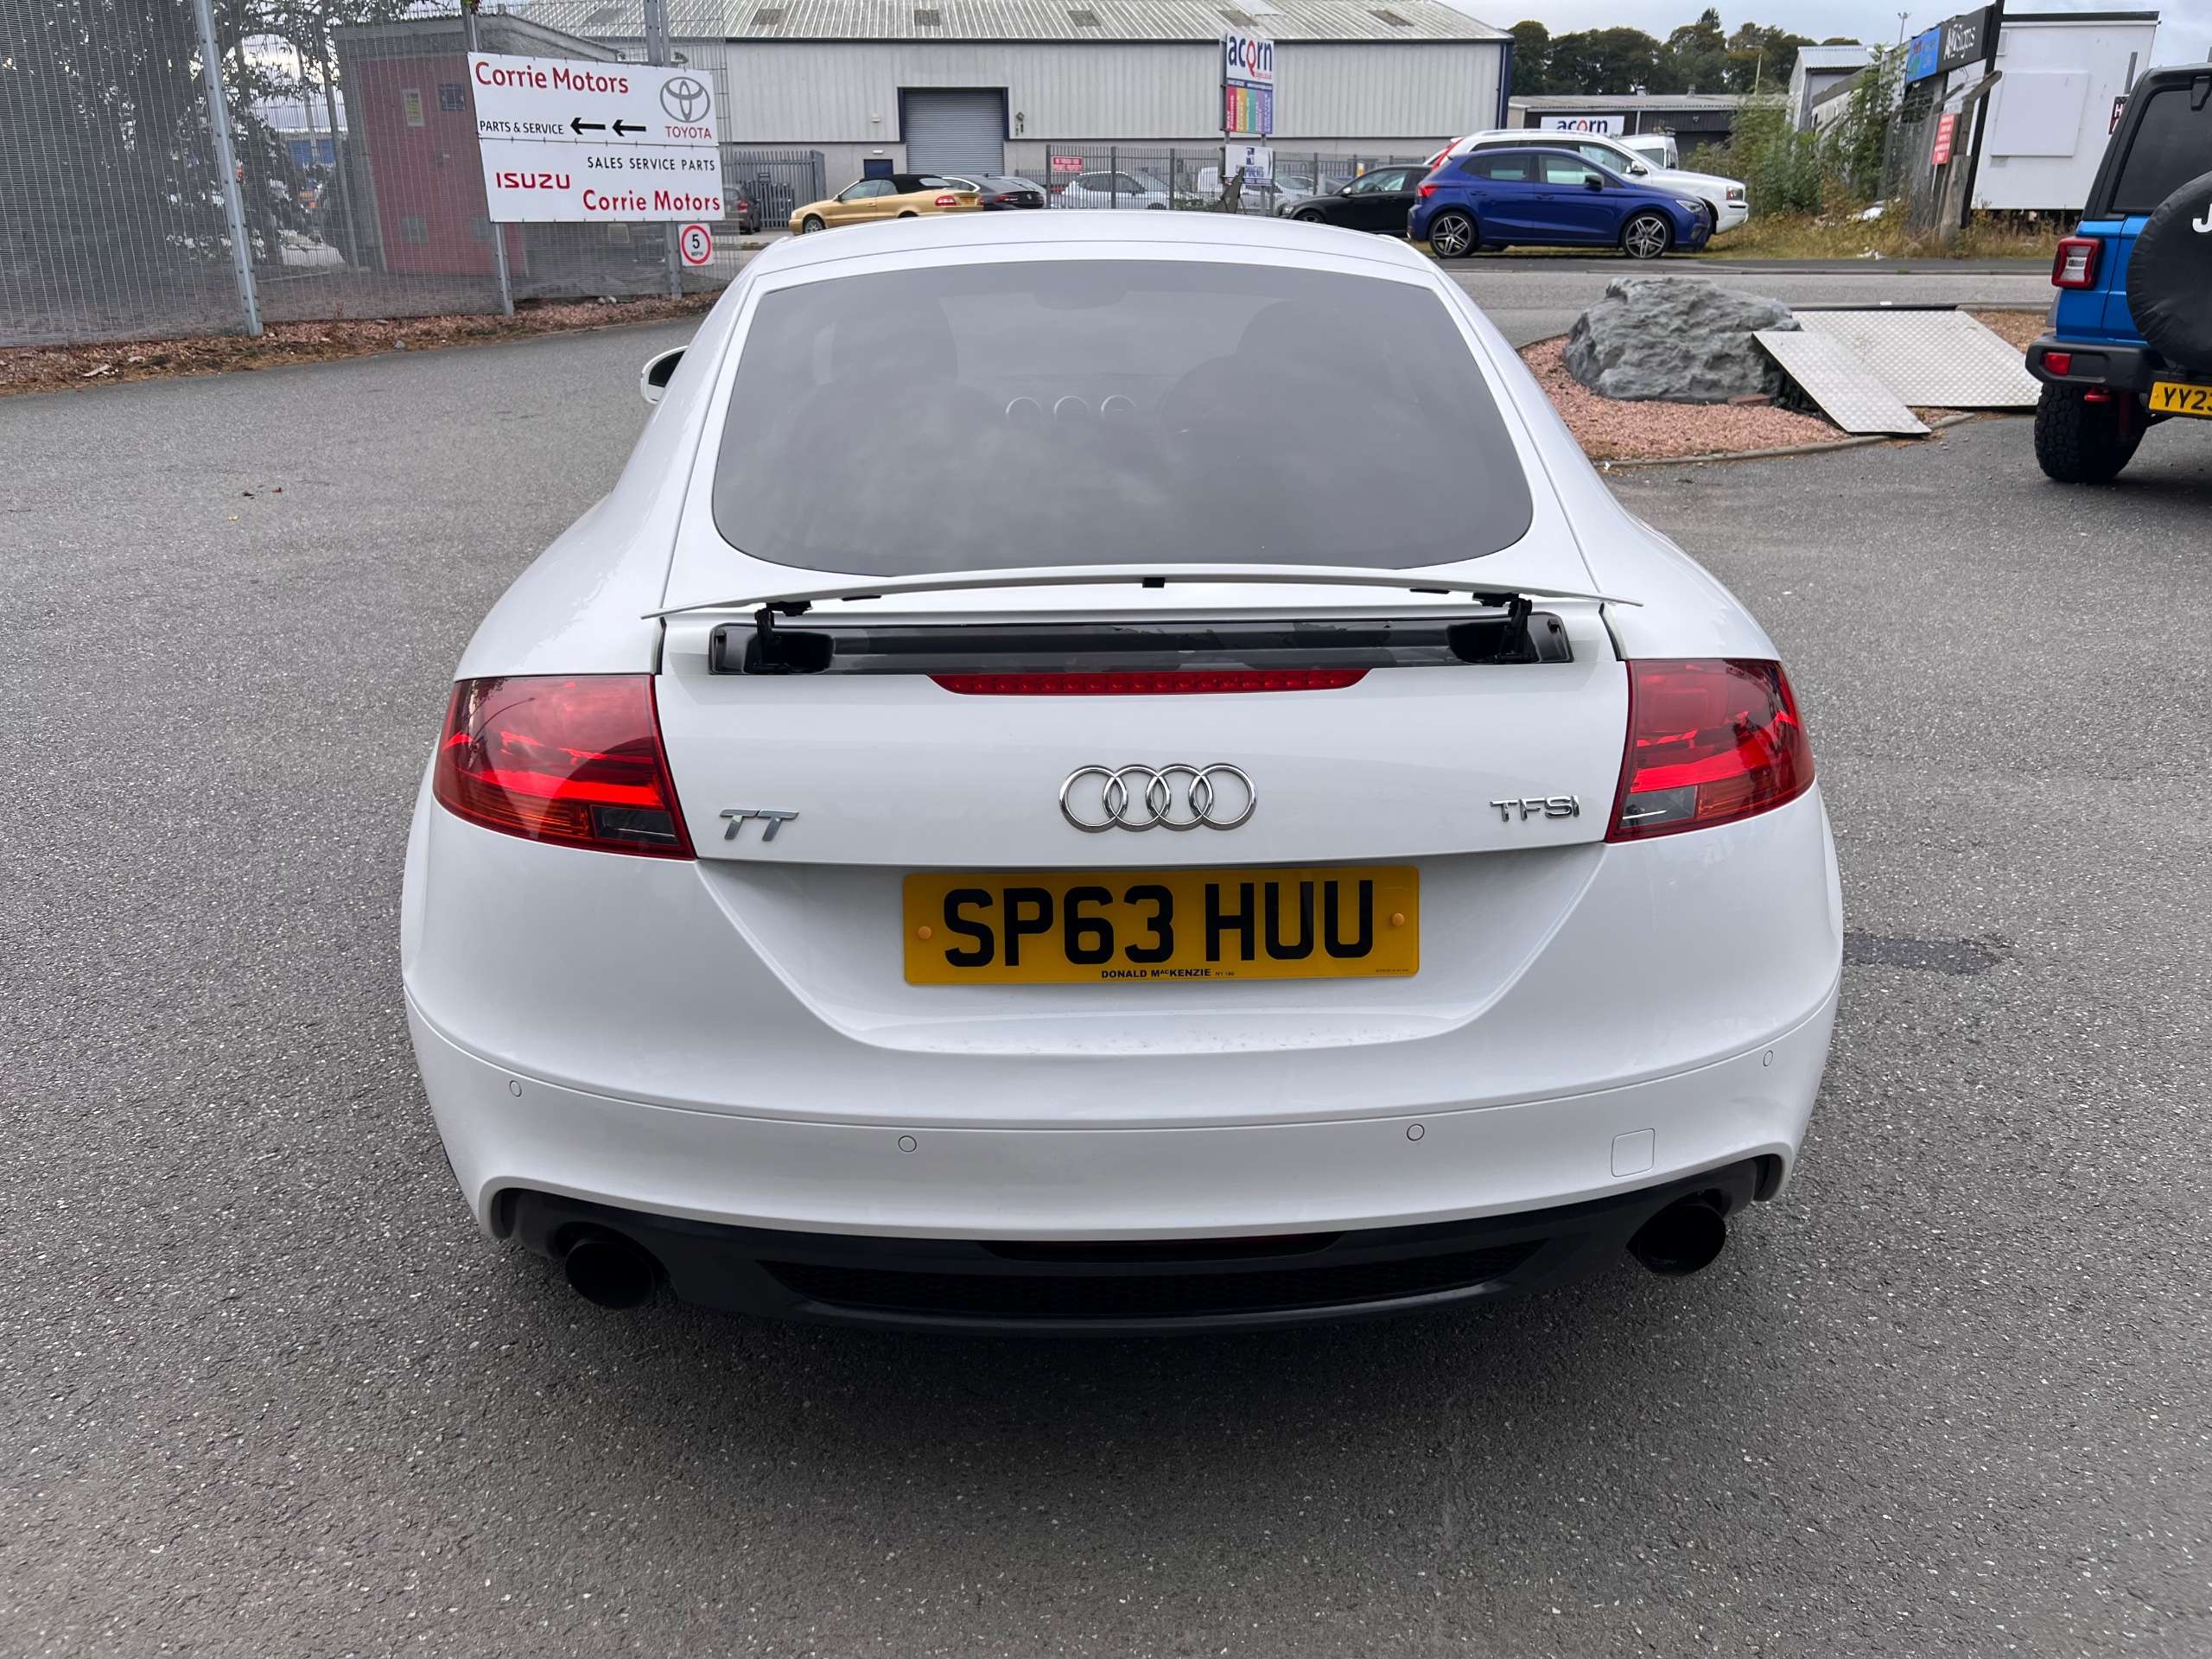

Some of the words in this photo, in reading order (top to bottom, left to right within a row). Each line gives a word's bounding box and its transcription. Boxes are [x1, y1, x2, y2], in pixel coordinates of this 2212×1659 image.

[1228, 35, 1273, 75] acorn
[475, 61, 547, 89] Corrie
[552, 67, 629, 93] Motors
[480, 120, 512, 132] PARTS
[513, 123, 521, 133] &
[523, 123, 564, 135] SERVICE
[664, 125, 712, 139] TOYOTA
[1556, 119, 1608, 133] acorn
[587, 156, 623, 169] SALES
[629, 158, 676, 170] SERVICE
[682, 159, 715, 171] PARTS
[495, 172, 571, 189] ISUZU
[583, 189, 647, 211] Corrie
[654, 190, 721, 211] Motors
[692, 233, 700, 249] 5
[719, 808, 800, 842] TT
[944, 886, 1175, 968] SP63
[1205, 879, 1374, 963] HUU
[1101, 969, 1147, 978] DONALD
